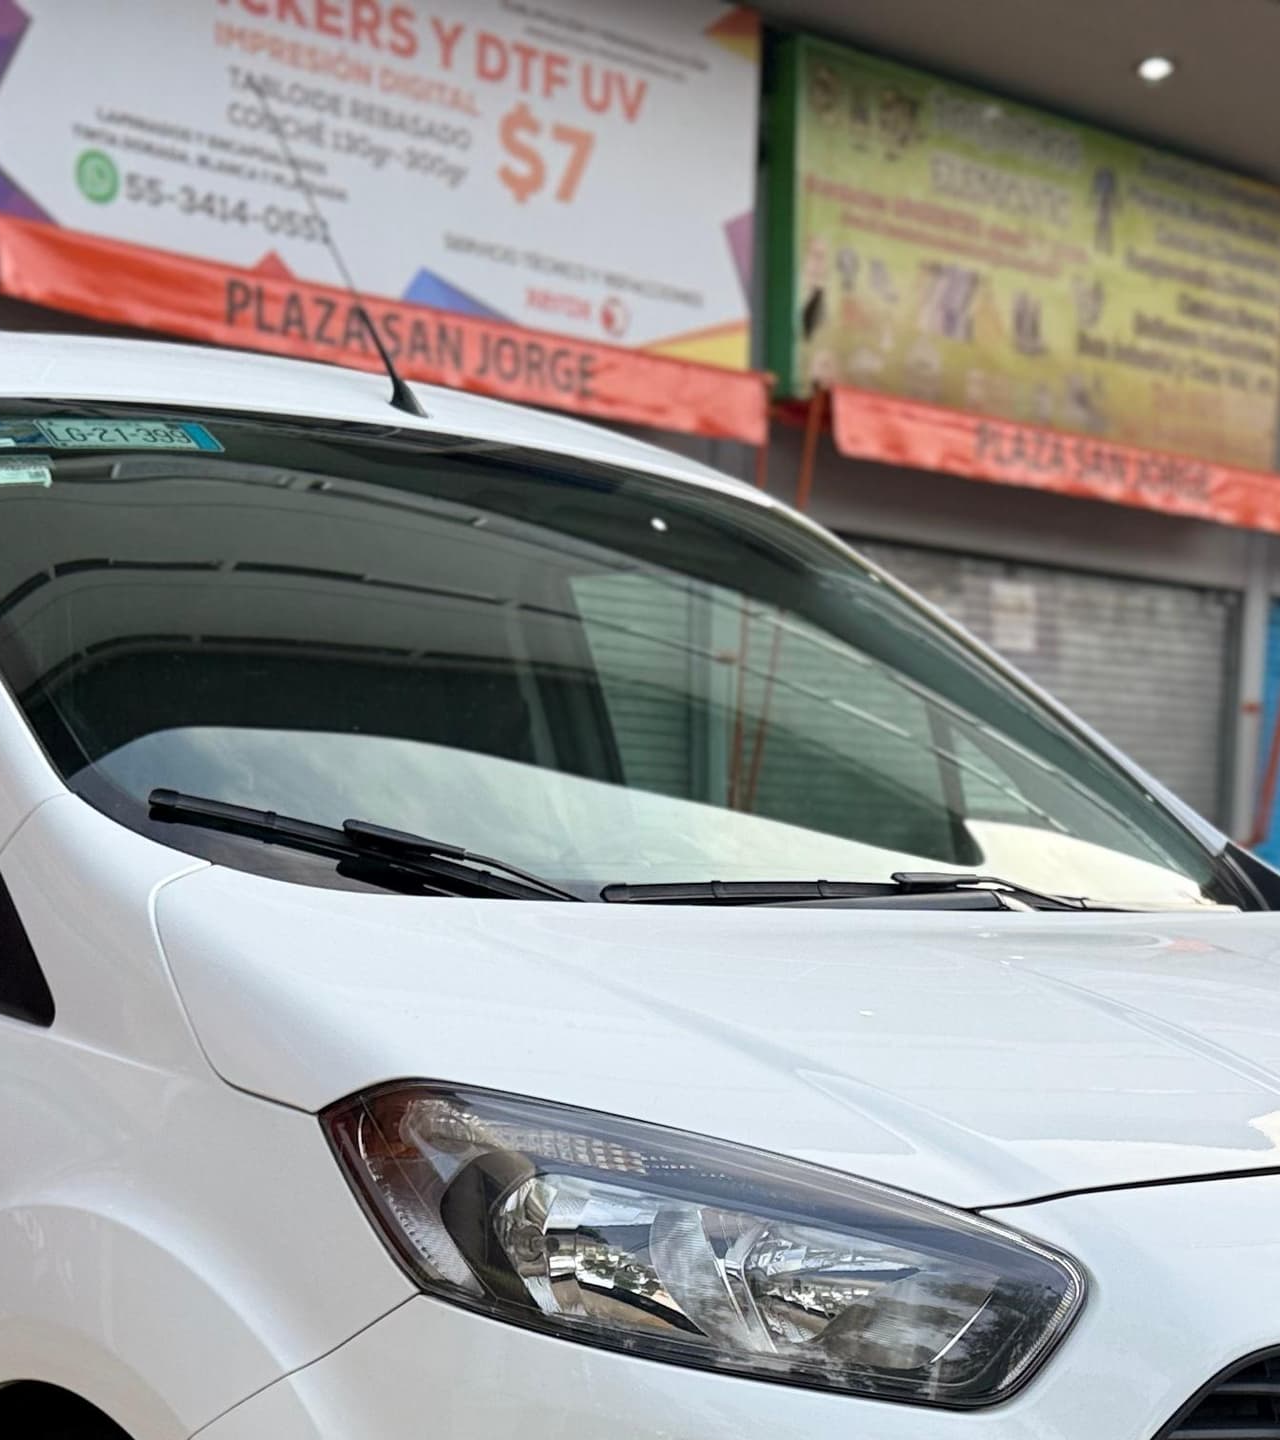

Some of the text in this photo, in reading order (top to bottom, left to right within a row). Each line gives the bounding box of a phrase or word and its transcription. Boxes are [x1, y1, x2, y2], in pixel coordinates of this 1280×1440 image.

[213, 20, 481, 119] IMPRESIÓN DIGITAL
[427, 15, 466, 71] Y
[476, 31, 570, 99] DTF
[581, 63, 649, 124] UV
[497, 102, 597, 205] $7
[226, 279, 599, 399] PLAZA SAN JORGE
[48, 421, 193, 446] LG-21-399
